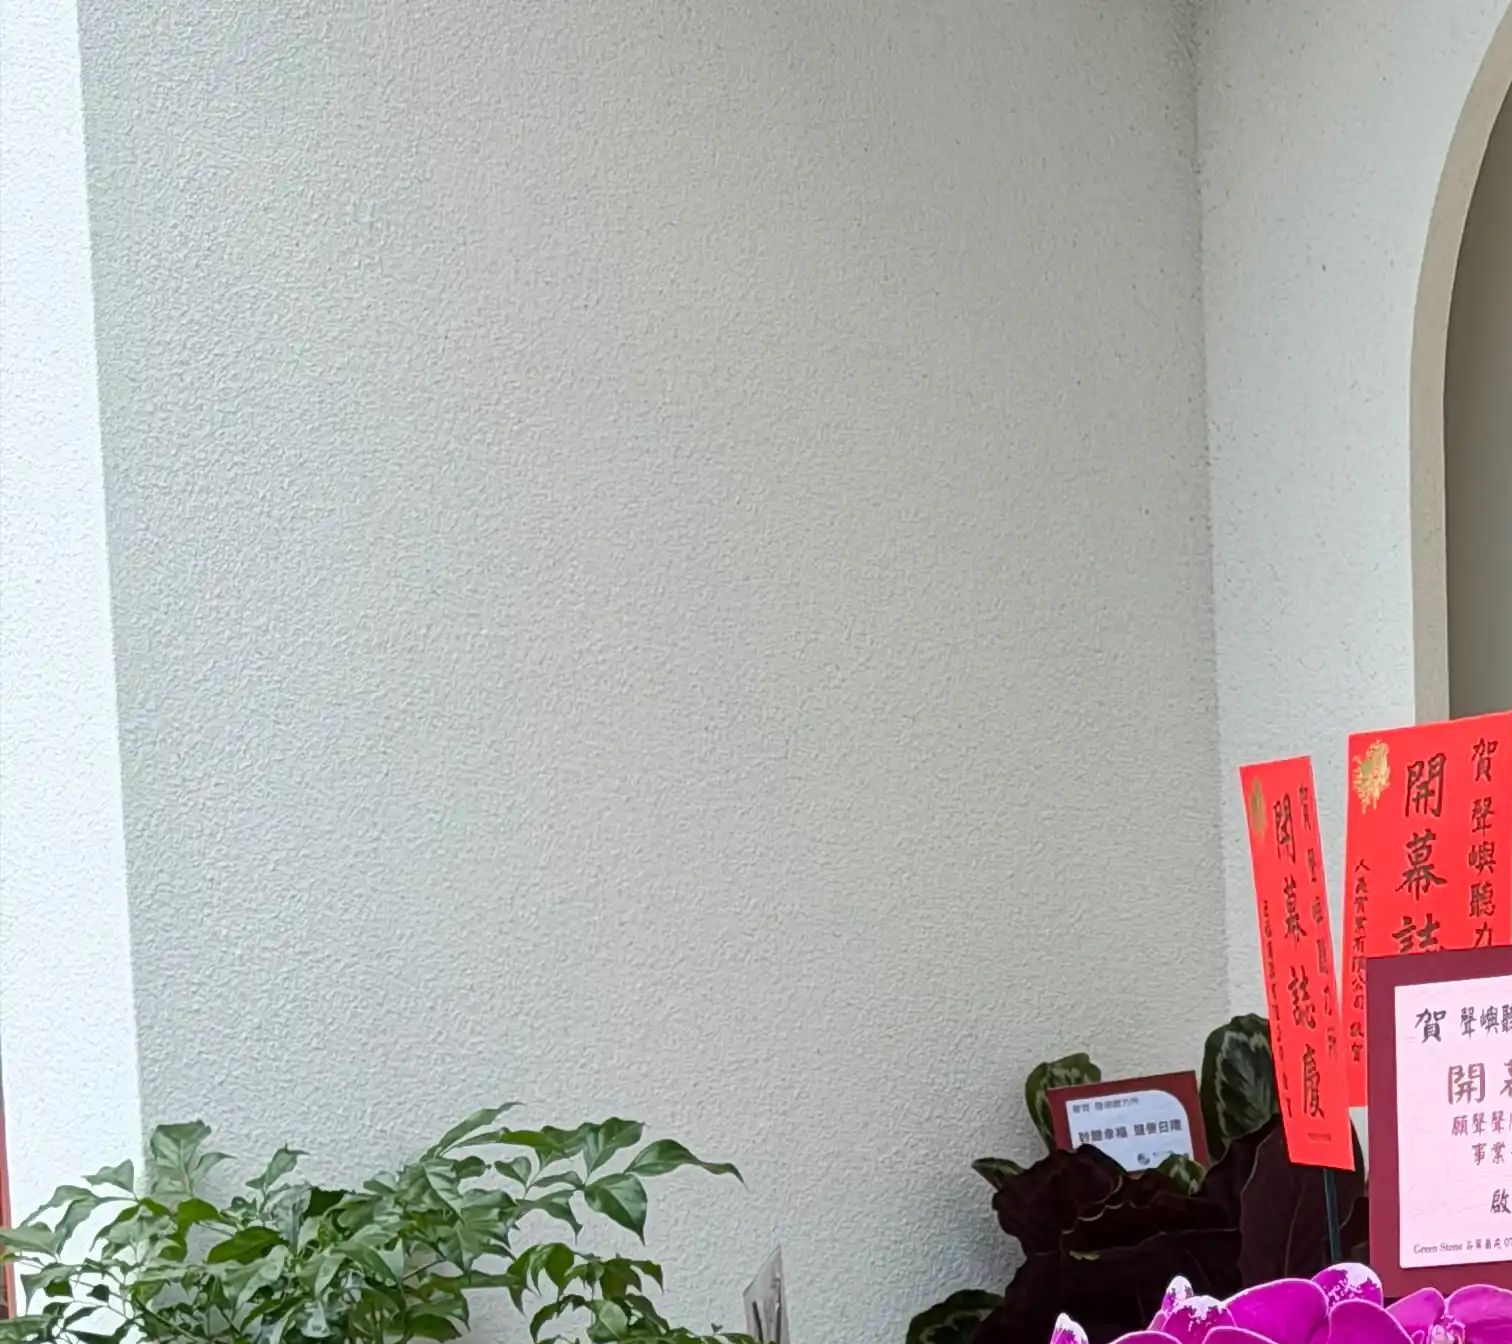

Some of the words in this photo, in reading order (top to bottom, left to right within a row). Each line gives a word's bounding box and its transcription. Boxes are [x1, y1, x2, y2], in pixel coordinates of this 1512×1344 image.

[1273, 792, 1326, 1119] 開幕誌慶
[1415, 1007, 1447, 1044] 賀
[1413, 1242, 1438, 1255] Green
